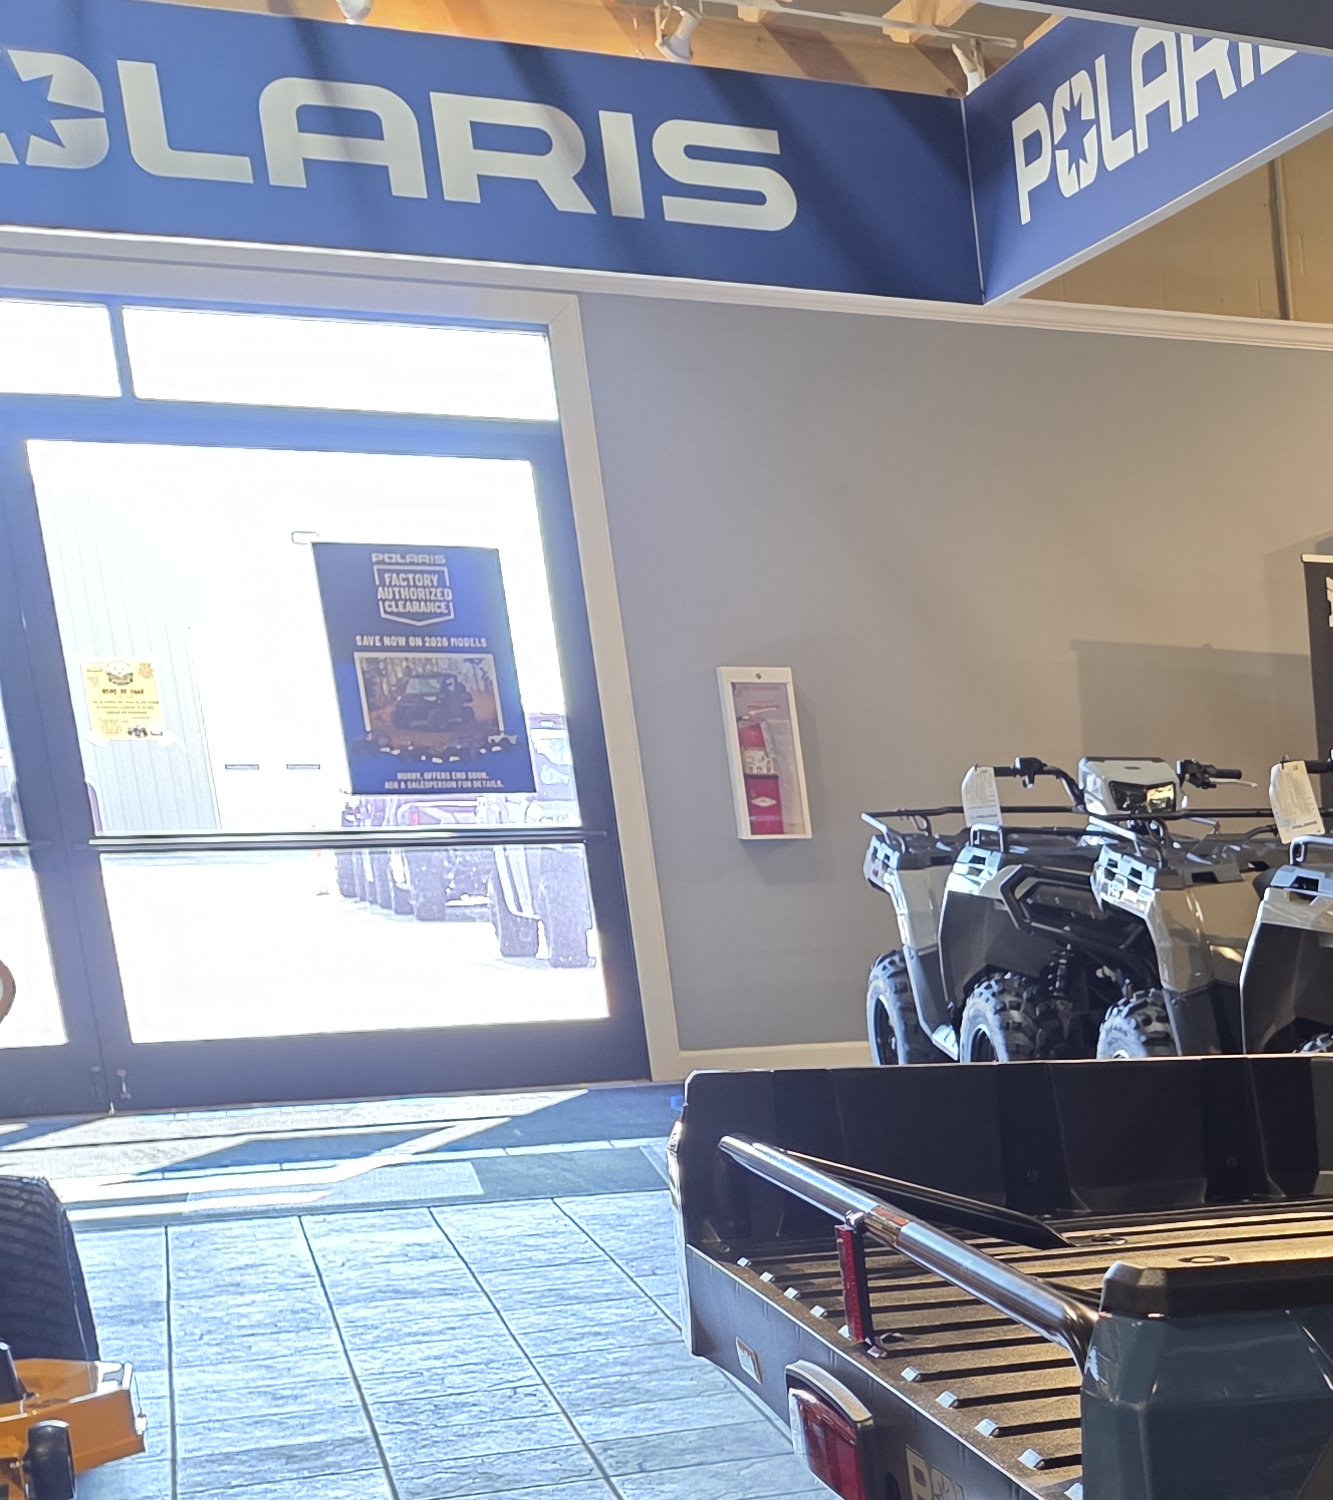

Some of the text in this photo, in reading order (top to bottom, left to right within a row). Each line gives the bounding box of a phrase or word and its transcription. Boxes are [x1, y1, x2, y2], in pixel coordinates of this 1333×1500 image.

[371, 553, 447, 564] POLARIS
[384, 573, 438, 586] FACTORY
[378, 586, 452, 601] AUTHORIZED
[384, 600, 448, 613] CLEARANCE
[356, 635, 381, 647] SAVE
[383, 636, 406, 647] NOW
[408, 637, 422, 647] ON
[450, 638, 487, 648] MODELS
